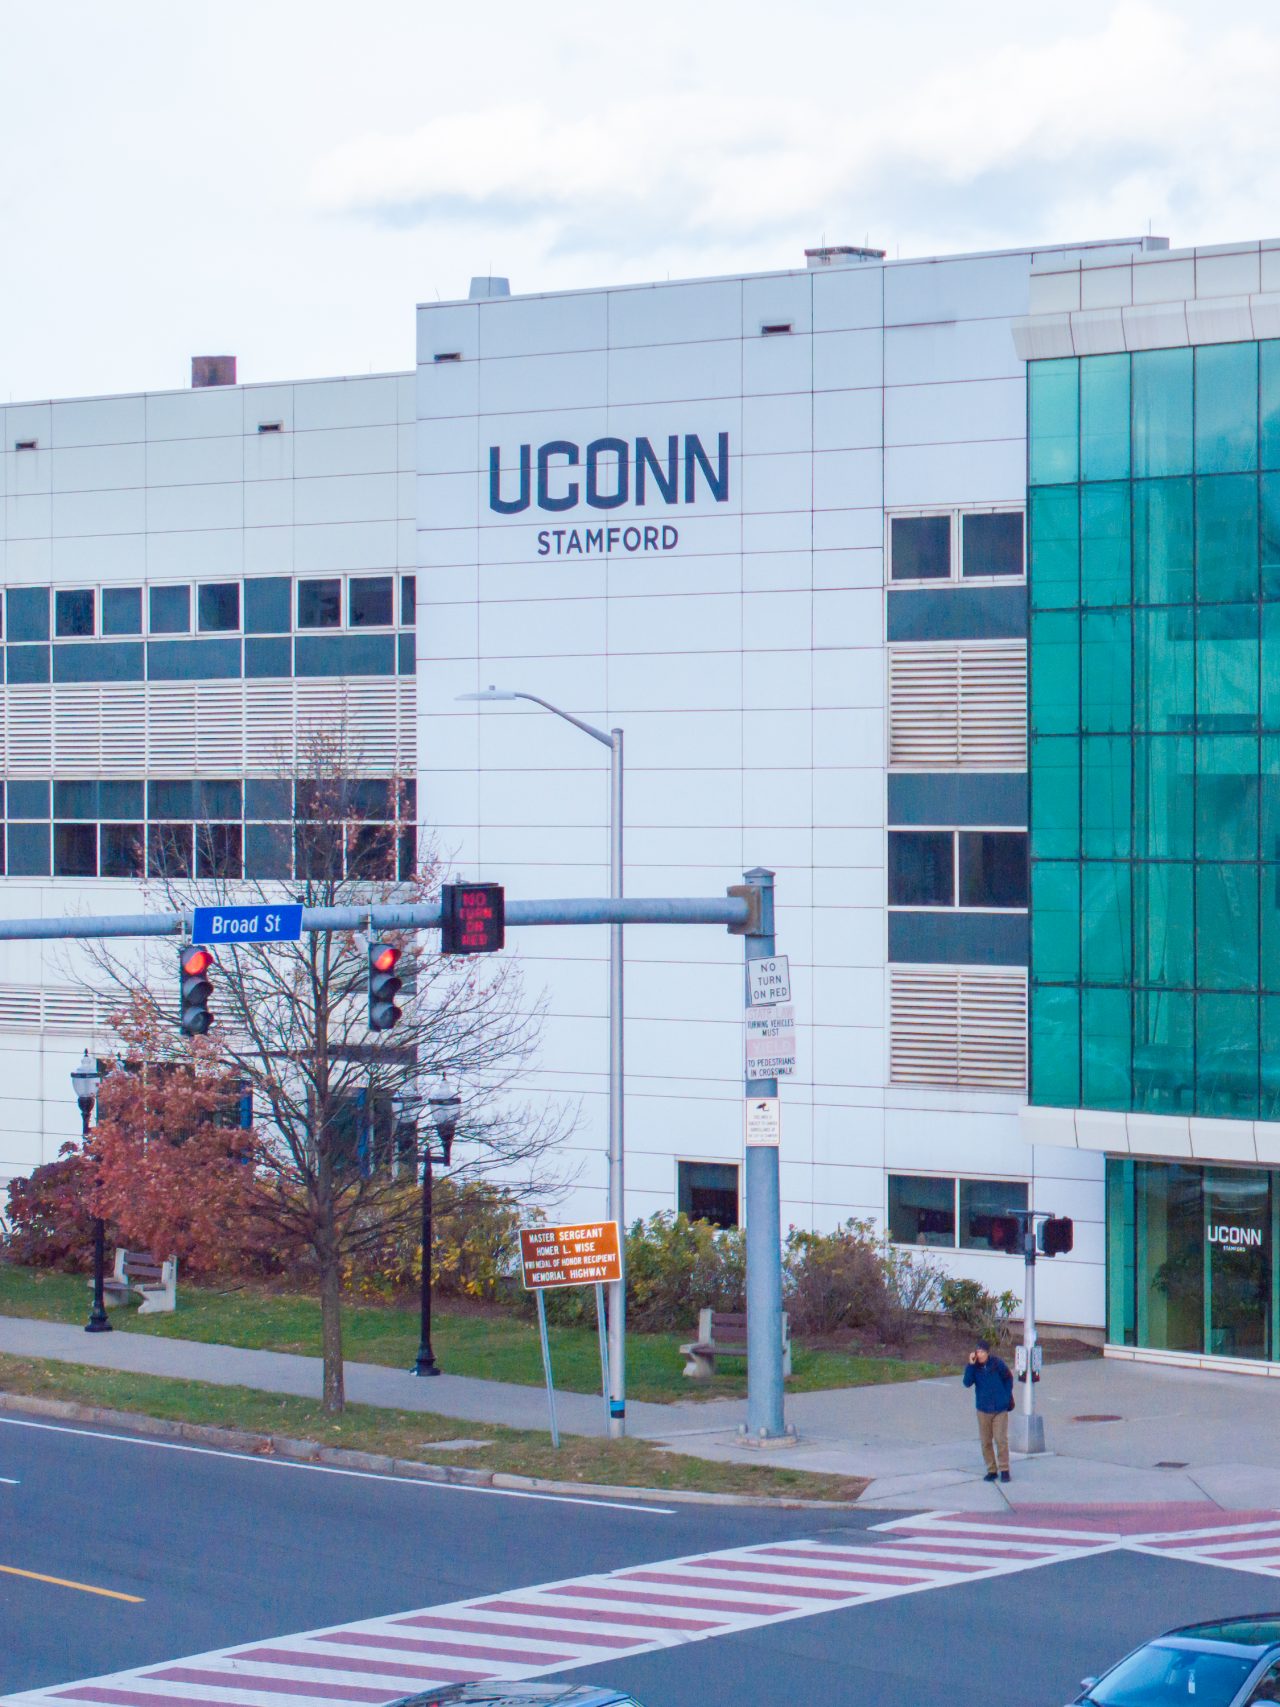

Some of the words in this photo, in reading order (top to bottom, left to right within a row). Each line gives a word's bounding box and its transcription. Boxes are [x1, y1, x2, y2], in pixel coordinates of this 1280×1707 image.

[489, 431, 729, 515] UCONN
[537, 525, 679, 556] STAMFORD
[212, 915, 259, 935] Broad
[264, 914, 281, 932] St
[761, 963, 776, 972] NO
[757, 975, 782, 986] TURN
[753, 990, 767, 1000] ON
[769, 987, 787, 998] RED
[762, 1028, 780, 1037] MUST
[748, 1059, 756, 1068] TO
[757, 1056, 796, 1067] PEDESTRIANS
[750, 1068, 757, 1078] IN
[759, 1066, 793, 1077] CROSSWALK
[529, 1233, 554, 1243] MASTER
[559, 1228, 602, 1240] SERGEANT
[1207, 1225, 1262, 1246] UCONN
[537, 1246, 559, 1256] HOMER
[563, 1245, 571, 1254] L.
[575, 1242, 595, 1252] WISE
[562, 1257, 582, 1266] HONOR
[584, 1254, 616, 1263] RECIPIENT
[532, 1271, 566, 1282] MEMORIAL
[570, 1267, 607, 1279] HIGHWAY
